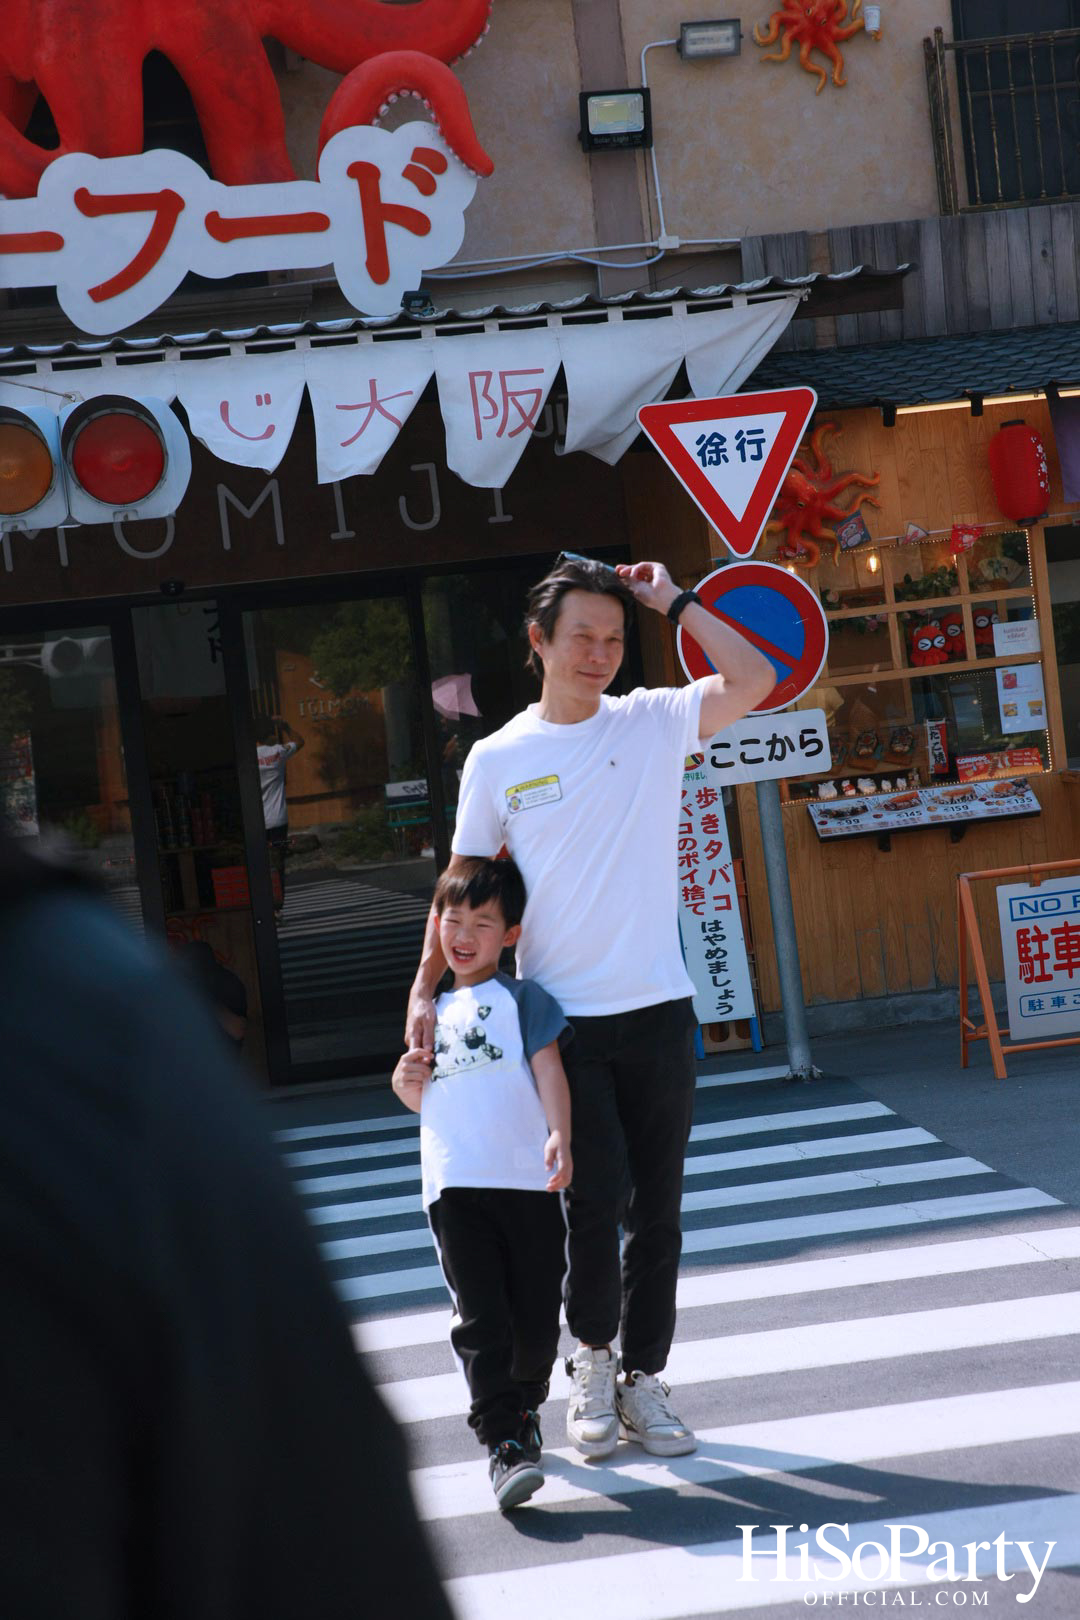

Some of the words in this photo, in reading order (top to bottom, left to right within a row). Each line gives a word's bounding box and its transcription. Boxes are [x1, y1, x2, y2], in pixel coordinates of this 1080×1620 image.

[696, 428, 766, 467] 徐行
[710, 729, 824, 769] ここから
[678, 789, 706, 916] バコのポイ捨て
[695, 786, 733, 911] 歩きタバコ
[1019, 897, 1062, 915] NO
[701, 920, 735, 1015] はやめましょう
[1016, 920, 1080, 984] 駐車
